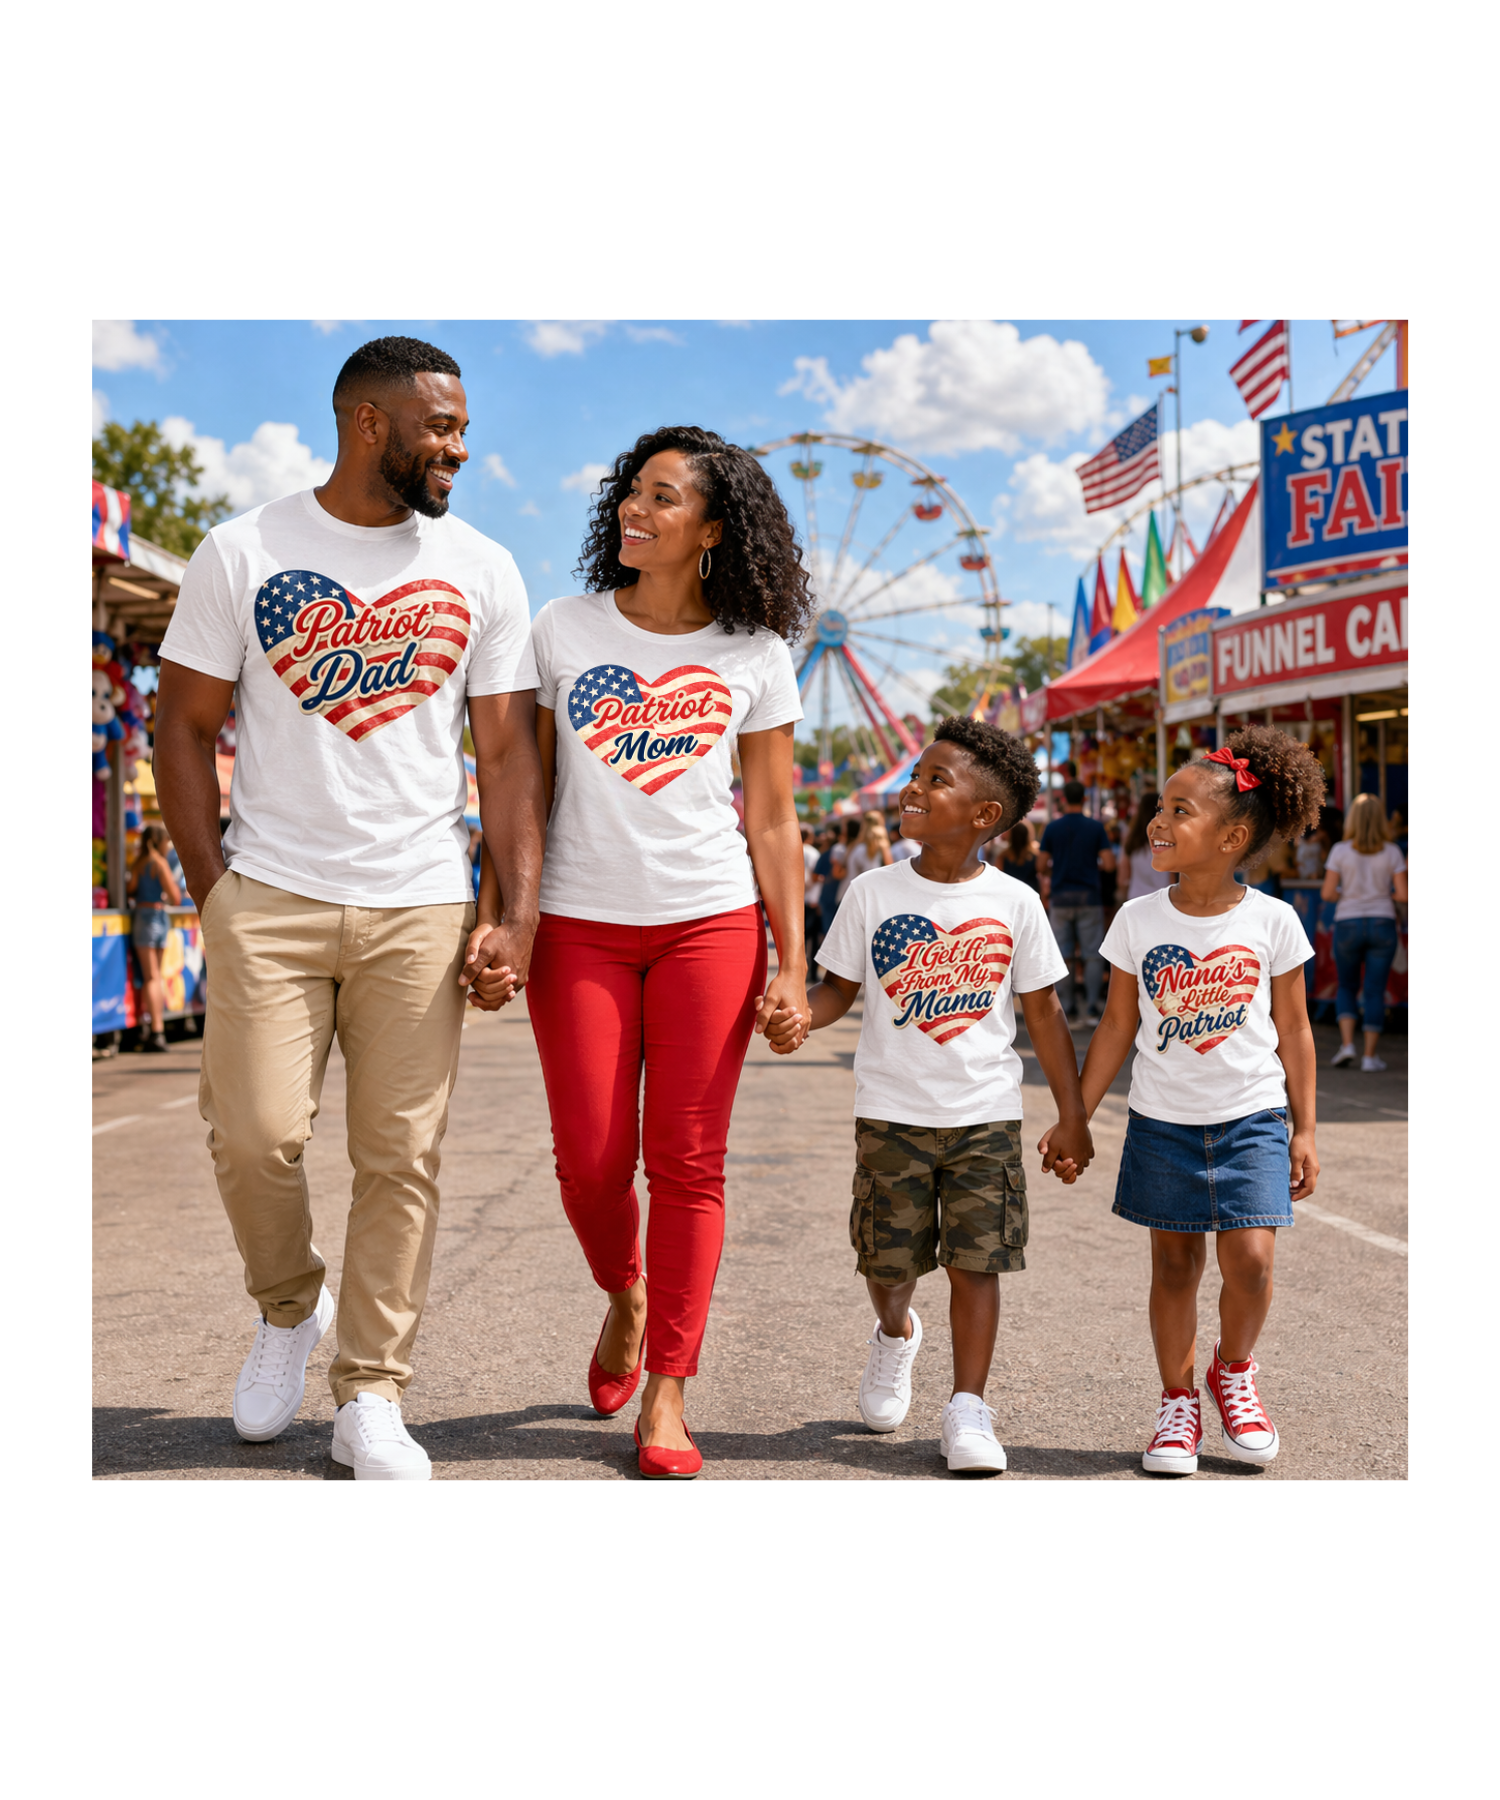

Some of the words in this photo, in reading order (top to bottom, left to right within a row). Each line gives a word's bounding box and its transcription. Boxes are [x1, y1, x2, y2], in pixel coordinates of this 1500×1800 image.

[1300, 408, 1408, 470] STAT
[1286, 455, 1408, 549] FAI
[292, 598, 433, 659] Patriot
[1217, 613, 1336, 686] FUNNEL
[300, 640, 418, 712] Dad
[592, 690, 715, 730] Patriot
[609, 730, 699, 765] Mom
[899, 941, 927, 974] I
[920, 940, 961, 972] Get
[959, 936, 986, 963] It
[1156, 955, 1246, 999] Nana's
[897, 969, 953, 995] From
[953, 963, 990, 989] My
[1176, 985, 1232, 1013] Little
[893, 988, 995, 1028] Mama
[1157, 1003, 1248, 1053] Patriot
